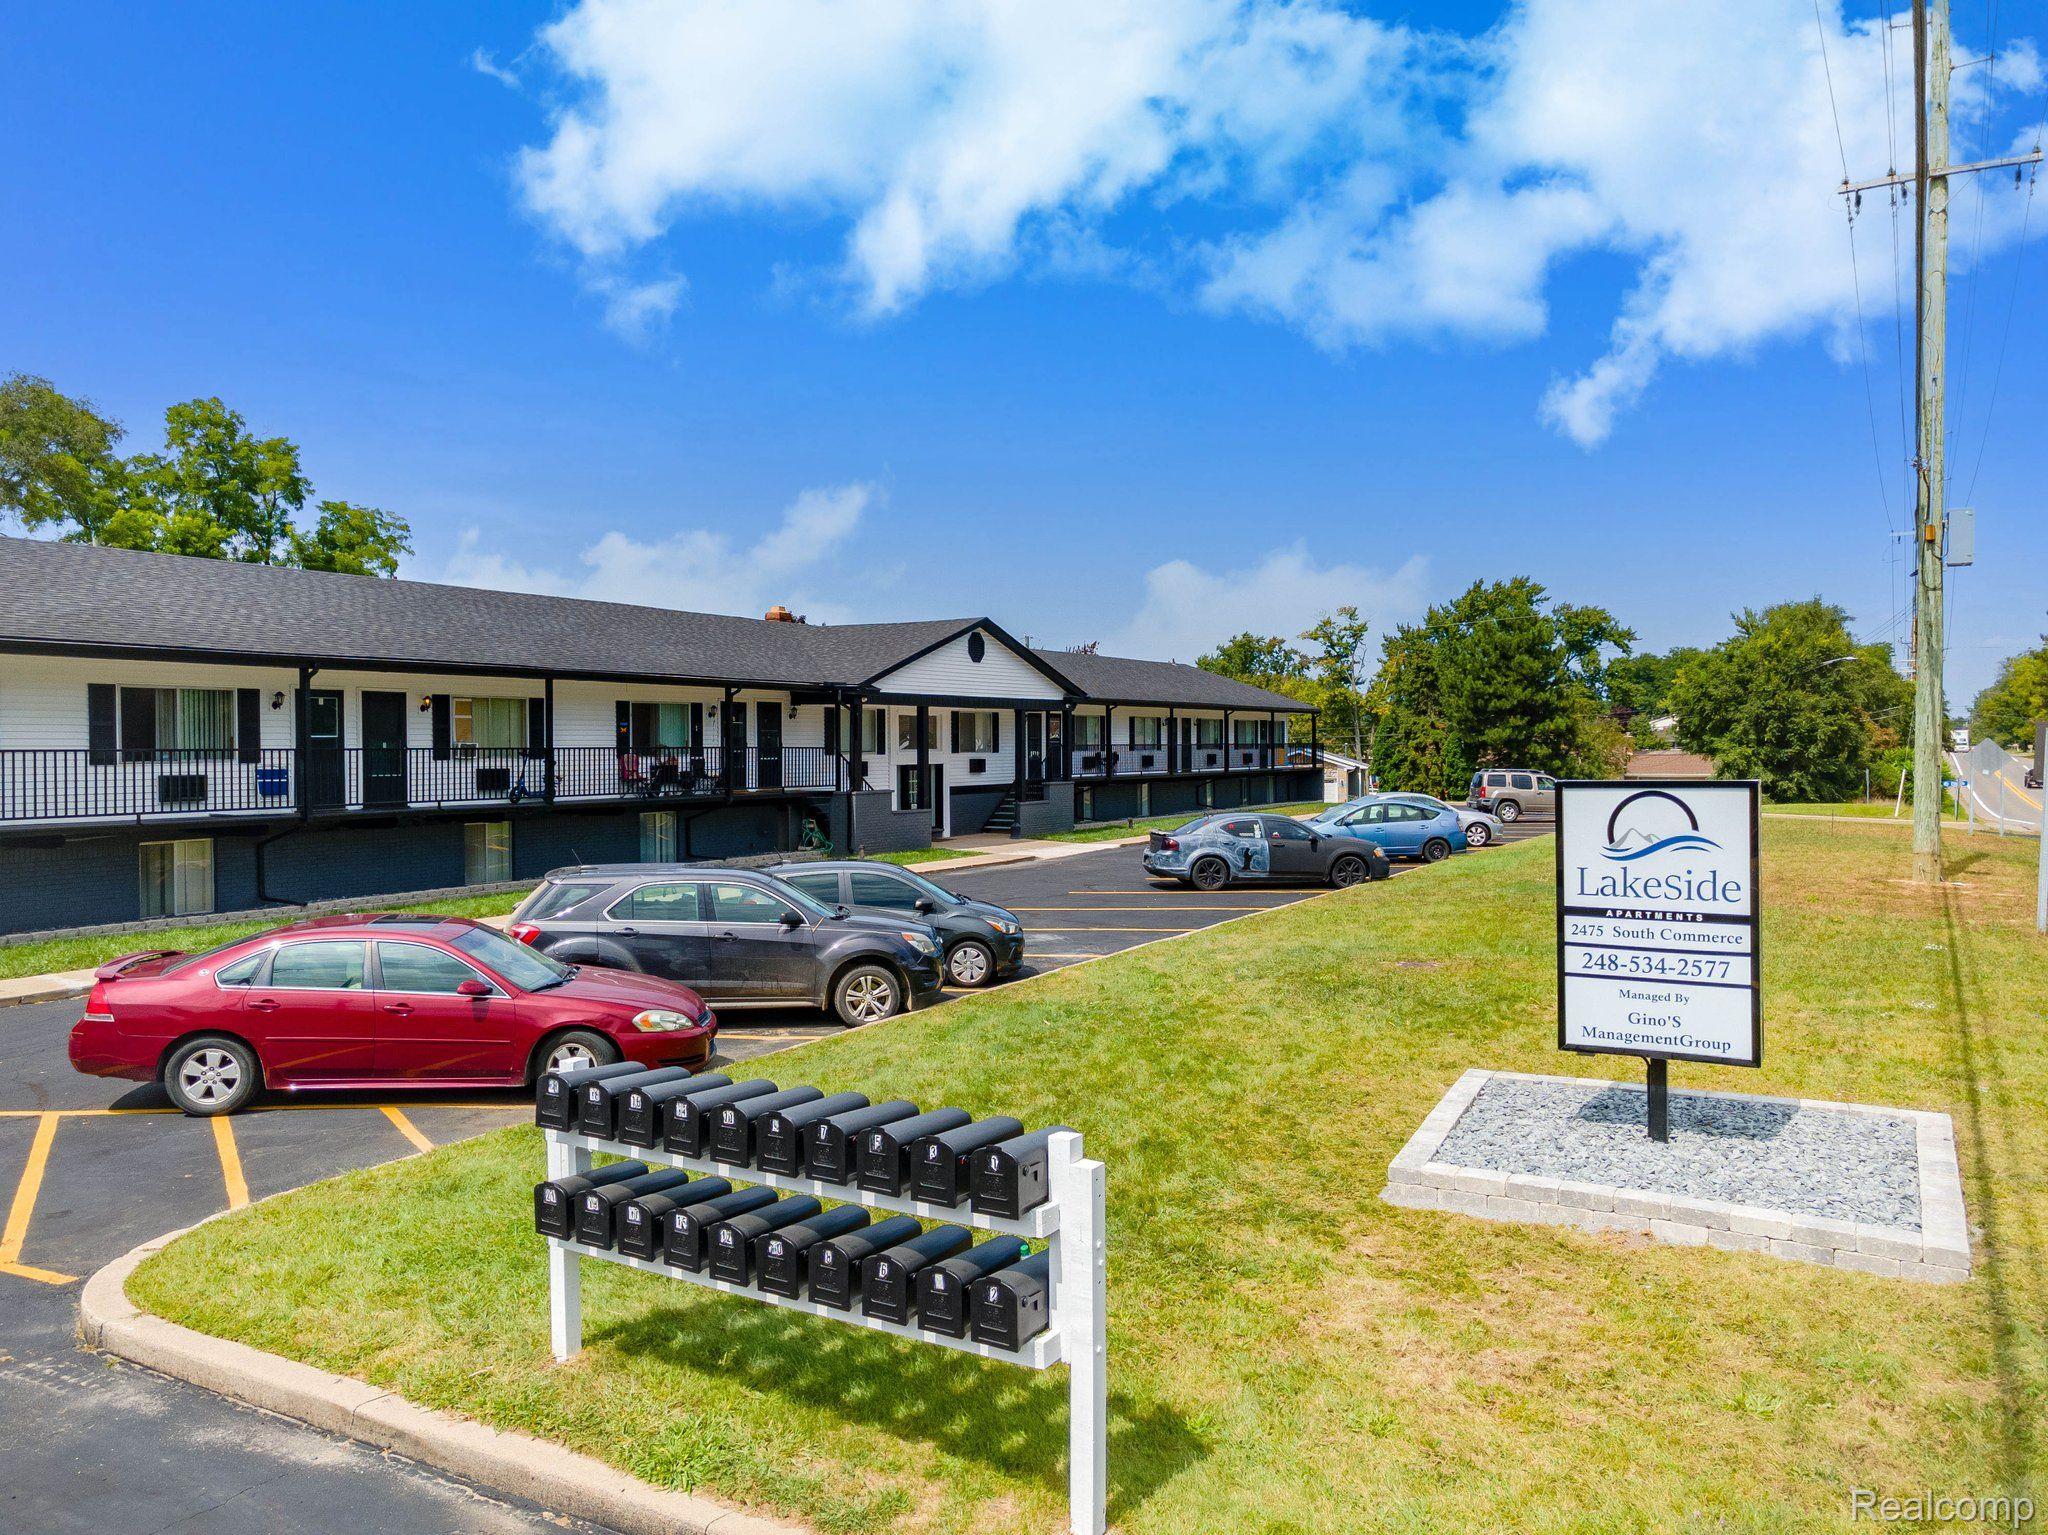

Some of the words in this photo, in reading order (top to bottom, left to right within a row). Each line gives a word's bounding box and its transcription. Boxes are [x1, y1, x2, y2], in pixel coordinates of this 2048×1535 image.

[1577, 866, 1742, 903] LakeSide
[1606, 909, 1703, 922] APARTMENTS
[1571, 923, 1604, 937] 2475
[1612, 925, 1655, 940] South
[1660, 928, 1743, 945] Commerce
[1582, 952, 1730, 979] 248-534-2577
[1619, 989, 1671, 1003] Managed
[1675, 993, 1690, 1005] By
[1628, 1012, 1682, 1028] Gino'S
[1582, 1025, 1731, 1053] ManagementGroup
[879, 1262, 888, 1277] 6
